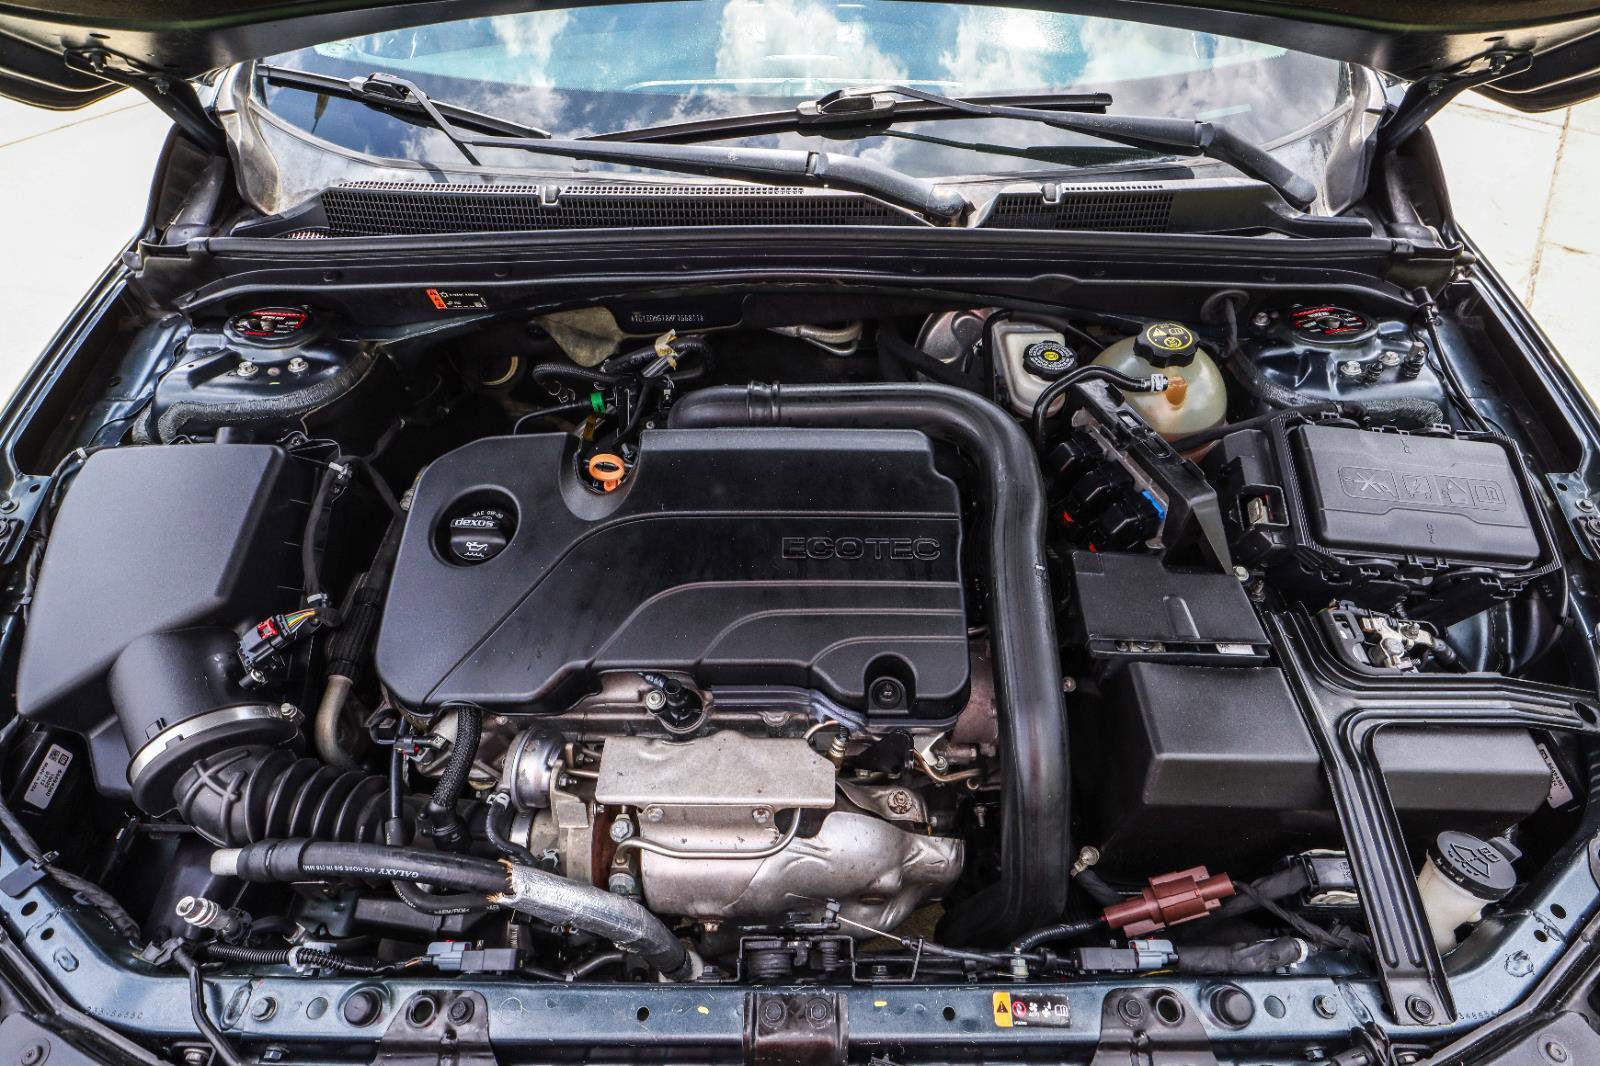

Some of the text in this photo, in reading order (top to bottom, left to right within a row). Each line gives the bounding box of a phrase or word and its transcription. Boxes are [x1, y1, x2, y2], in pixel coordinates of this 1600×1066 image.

[454, 517, 495, 527] dexos
[781, 537, 941, 560] ECOTEC
[378, 868, 419, 878] GALAXY
